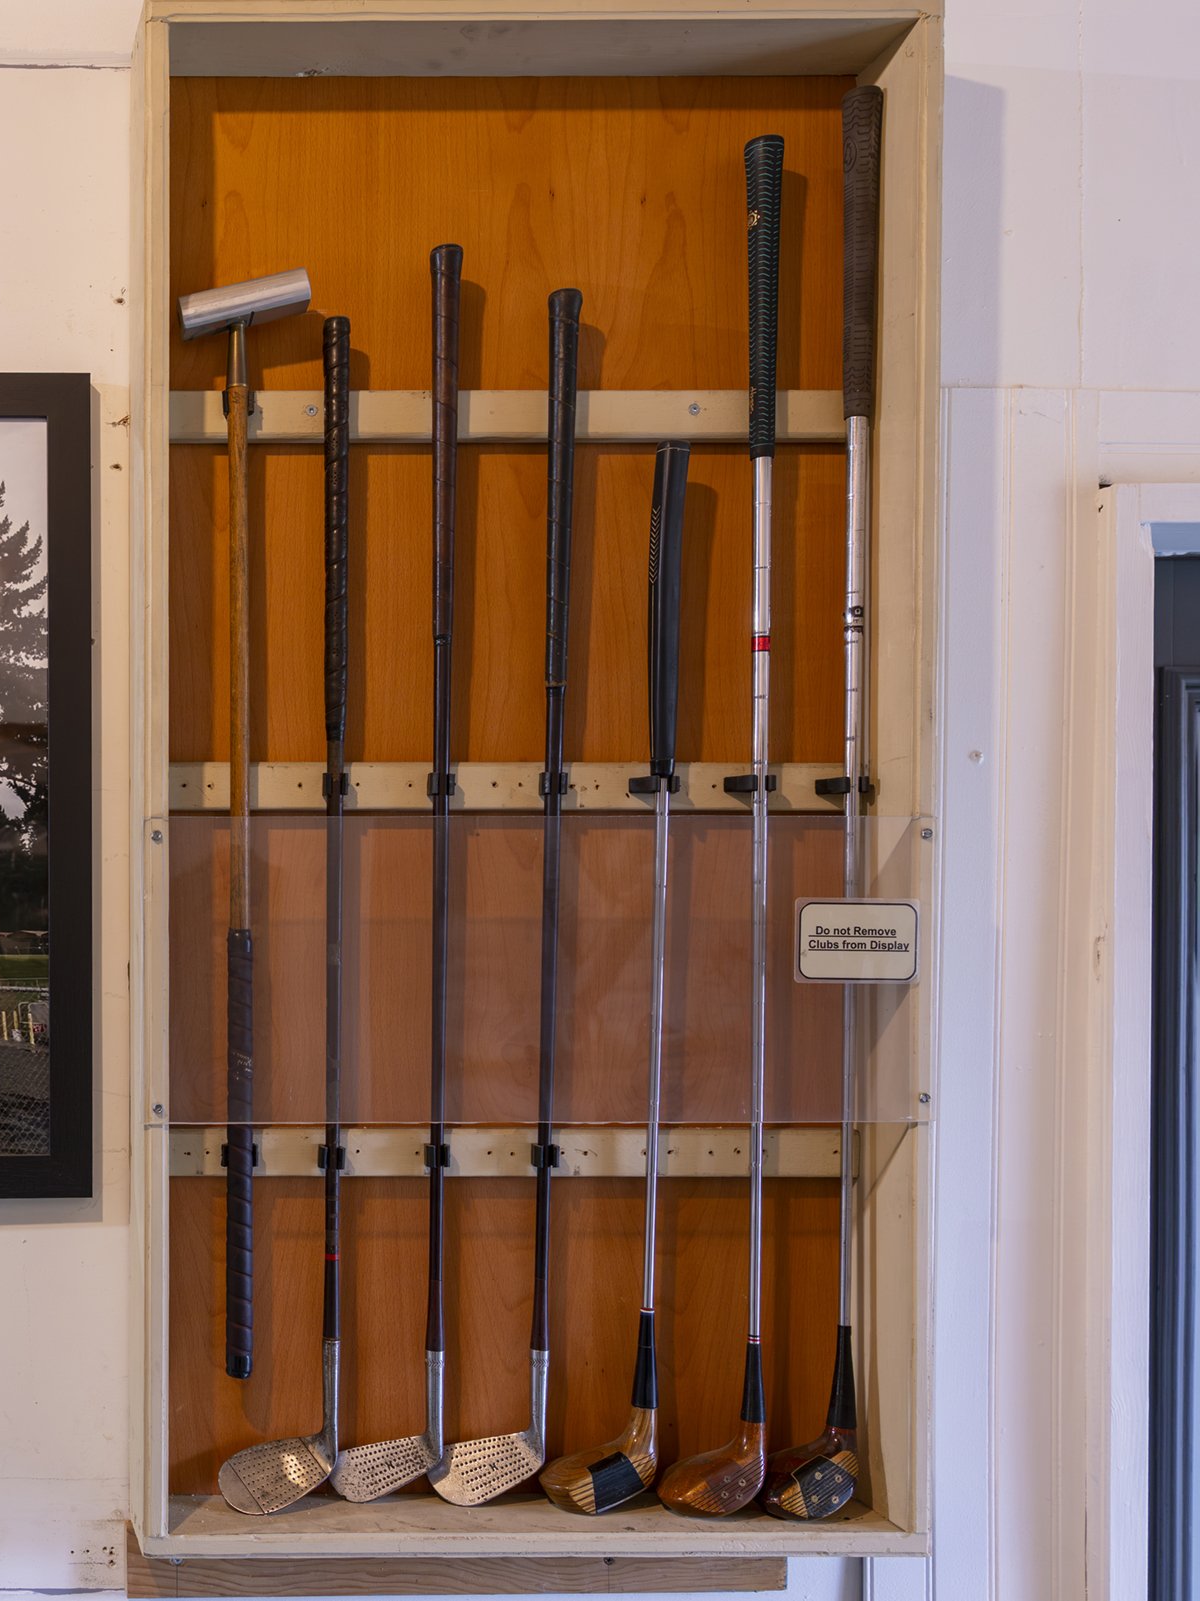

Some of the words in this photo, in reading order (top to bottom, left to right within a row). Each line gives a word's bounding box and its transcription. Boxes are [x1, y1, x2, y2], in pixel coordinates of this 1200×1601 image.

[815, 926, 830, 935] Do
[833, 927, 851, 936] not
[853, 926, 897, 936] Remove
[808, 940, 839, 949] Clubs
[842, 940, 867, 950] from
[870, 941, 910, 951] Display
